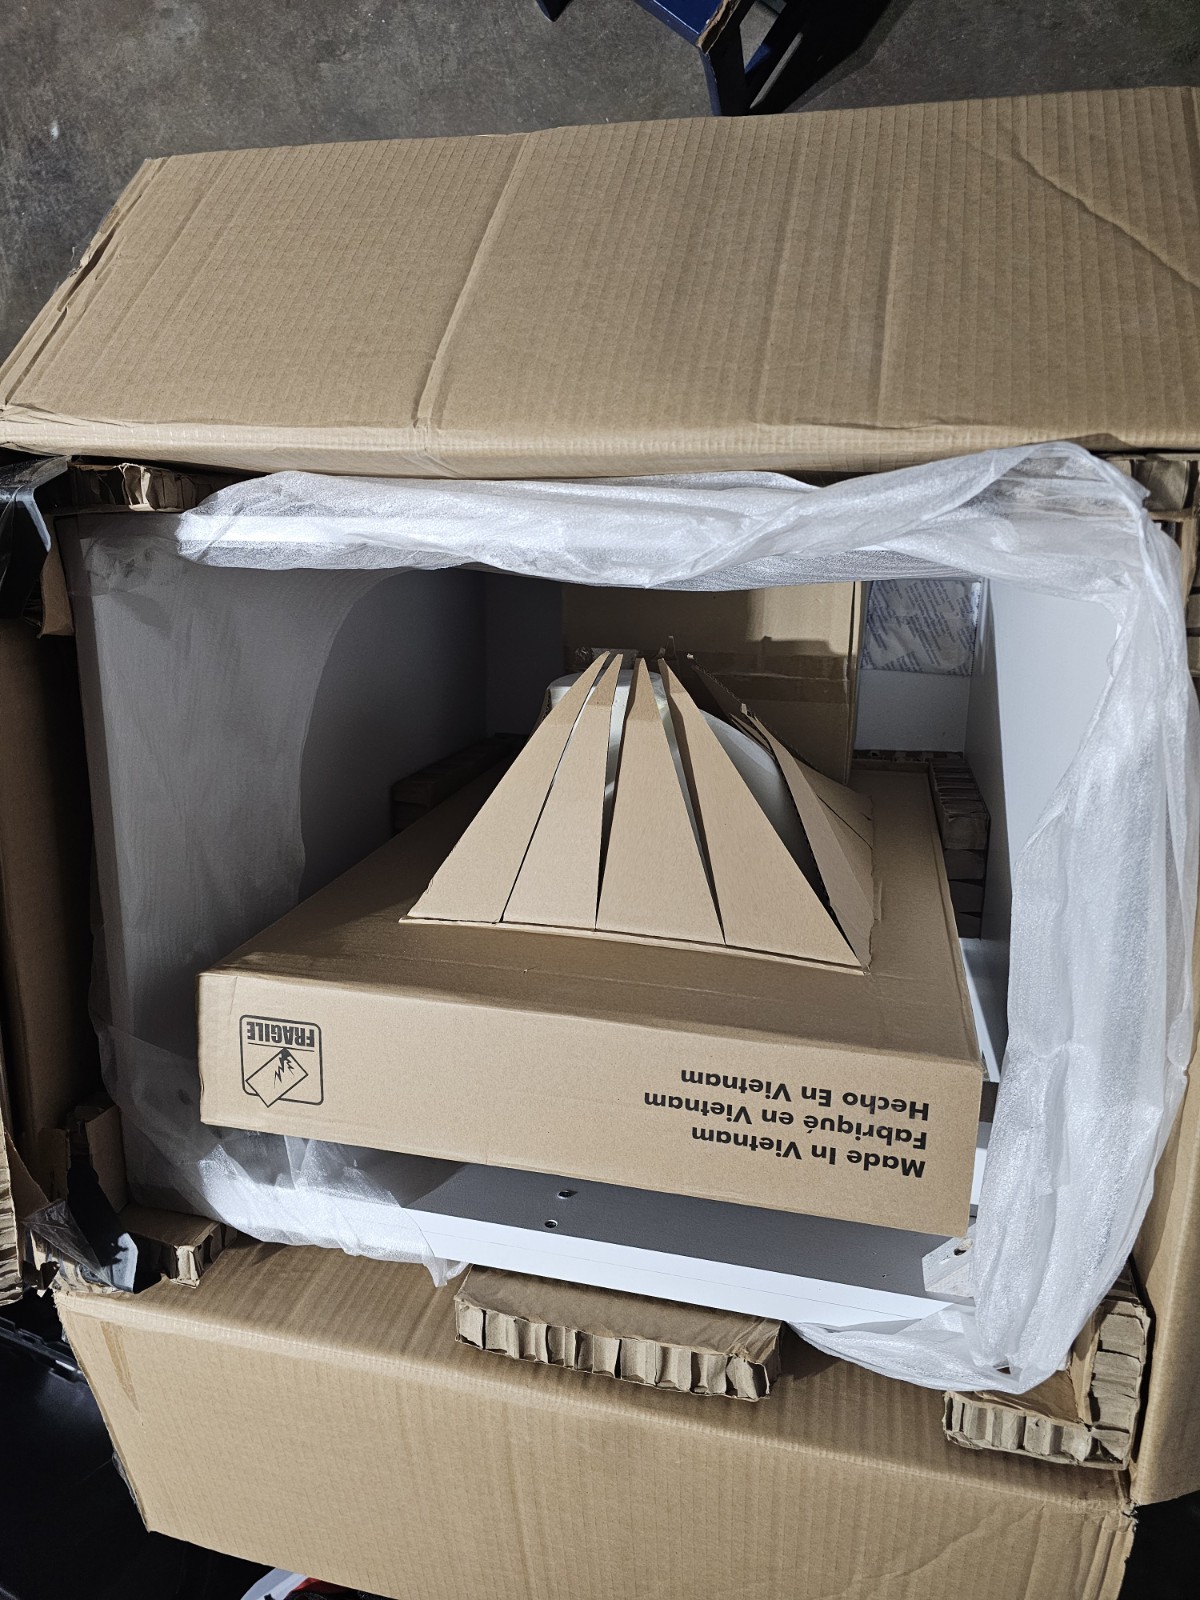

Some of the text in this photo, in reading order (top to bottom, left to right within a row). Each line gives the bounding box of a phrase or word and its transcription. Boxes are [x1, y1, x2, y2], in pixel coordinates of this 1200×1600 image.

[247, 1022, 315, 1048] FRAGILE
[682, 1070, 929, 1121] Hecho En Vietnam
[645, 1093, 927, 1150] Fabriqué en Vietnam
[692, 1127, 925, 1178] Made In Vietnam
